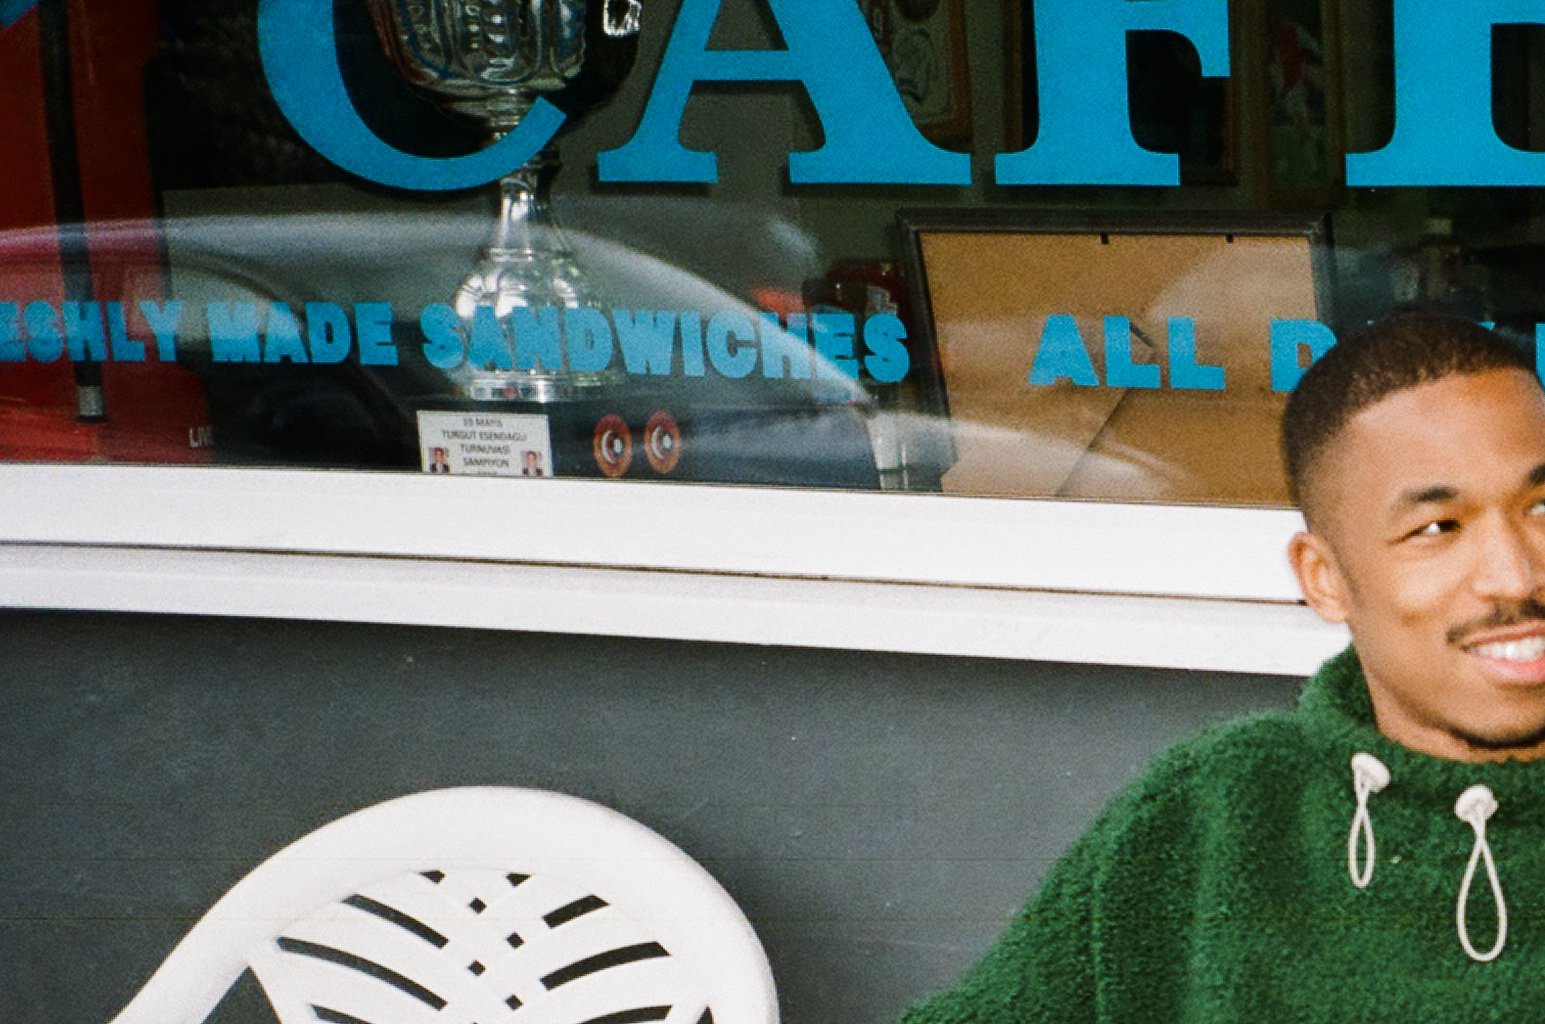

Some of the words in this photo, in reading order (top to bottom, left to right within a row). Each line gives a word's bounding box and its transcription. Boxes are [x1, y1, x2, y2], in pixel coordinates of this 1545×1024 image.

[207, 300, 398, 365] MADE
[420, 302, 911, 383] SANDWICHES
[1029, 313, 1226, 390] ALL
